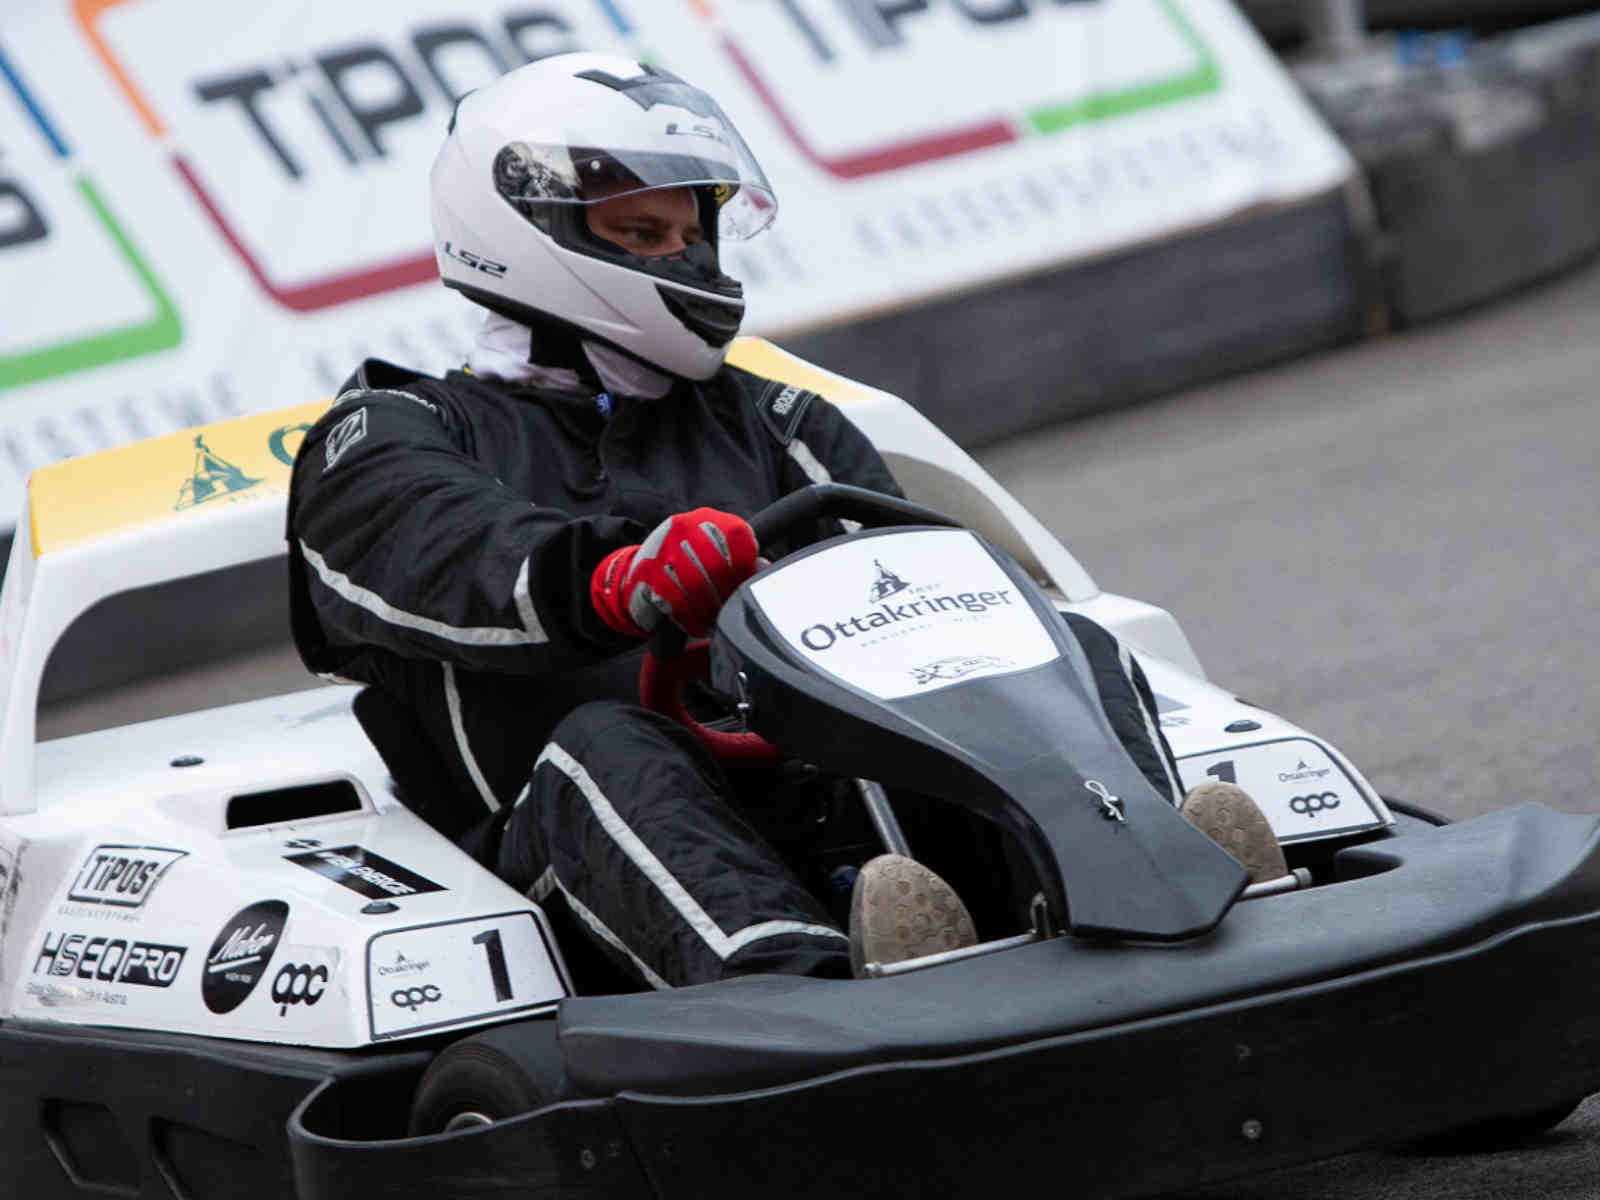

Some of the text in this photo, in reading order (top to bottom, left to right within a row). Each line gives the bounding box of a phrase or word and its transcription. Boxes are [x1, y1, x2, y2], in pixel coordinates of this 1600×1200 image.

[445, 241, 507, 279] LS2
[800, 589, 1013, 651] Ottakringer
[472, 929, 514, 1002] 1
